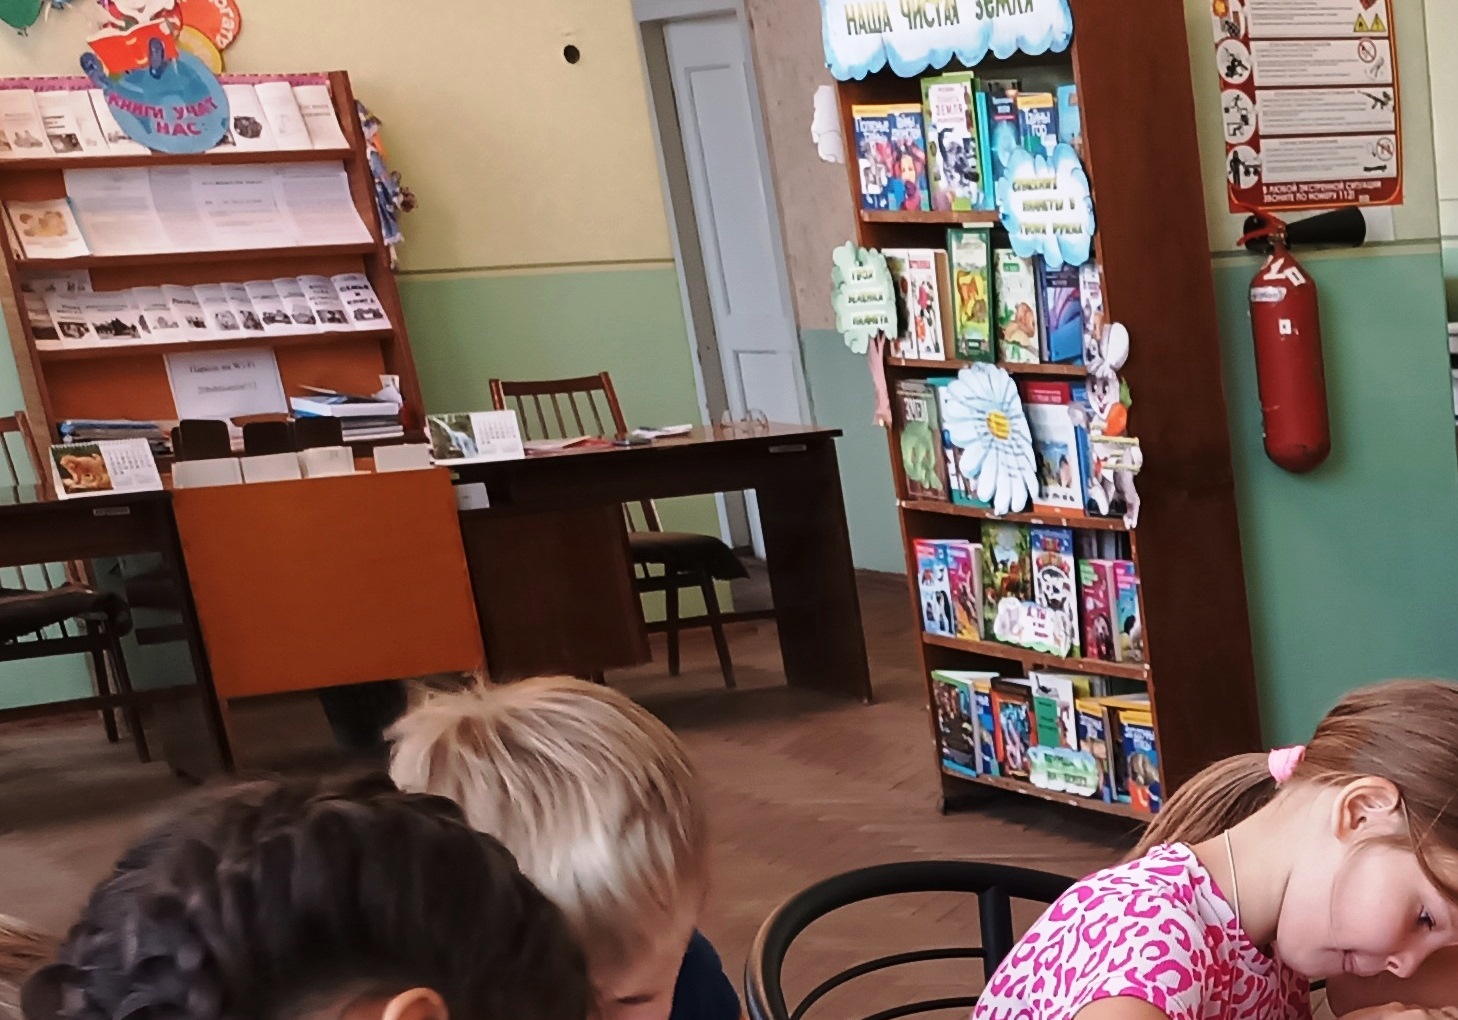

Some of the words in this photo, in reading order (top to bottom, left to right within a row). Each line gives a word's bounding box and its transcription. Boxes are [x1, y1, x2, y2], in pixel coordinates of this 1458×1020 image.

[845, 3, 893, 35] НАША
[900, 0, 960, 30] ЧИСТАЯ
[107, 92, 164, 121] КНИГИ
[173, 97, 217, 120] УЧАТ
[156, 122, 202, 136] НАС
